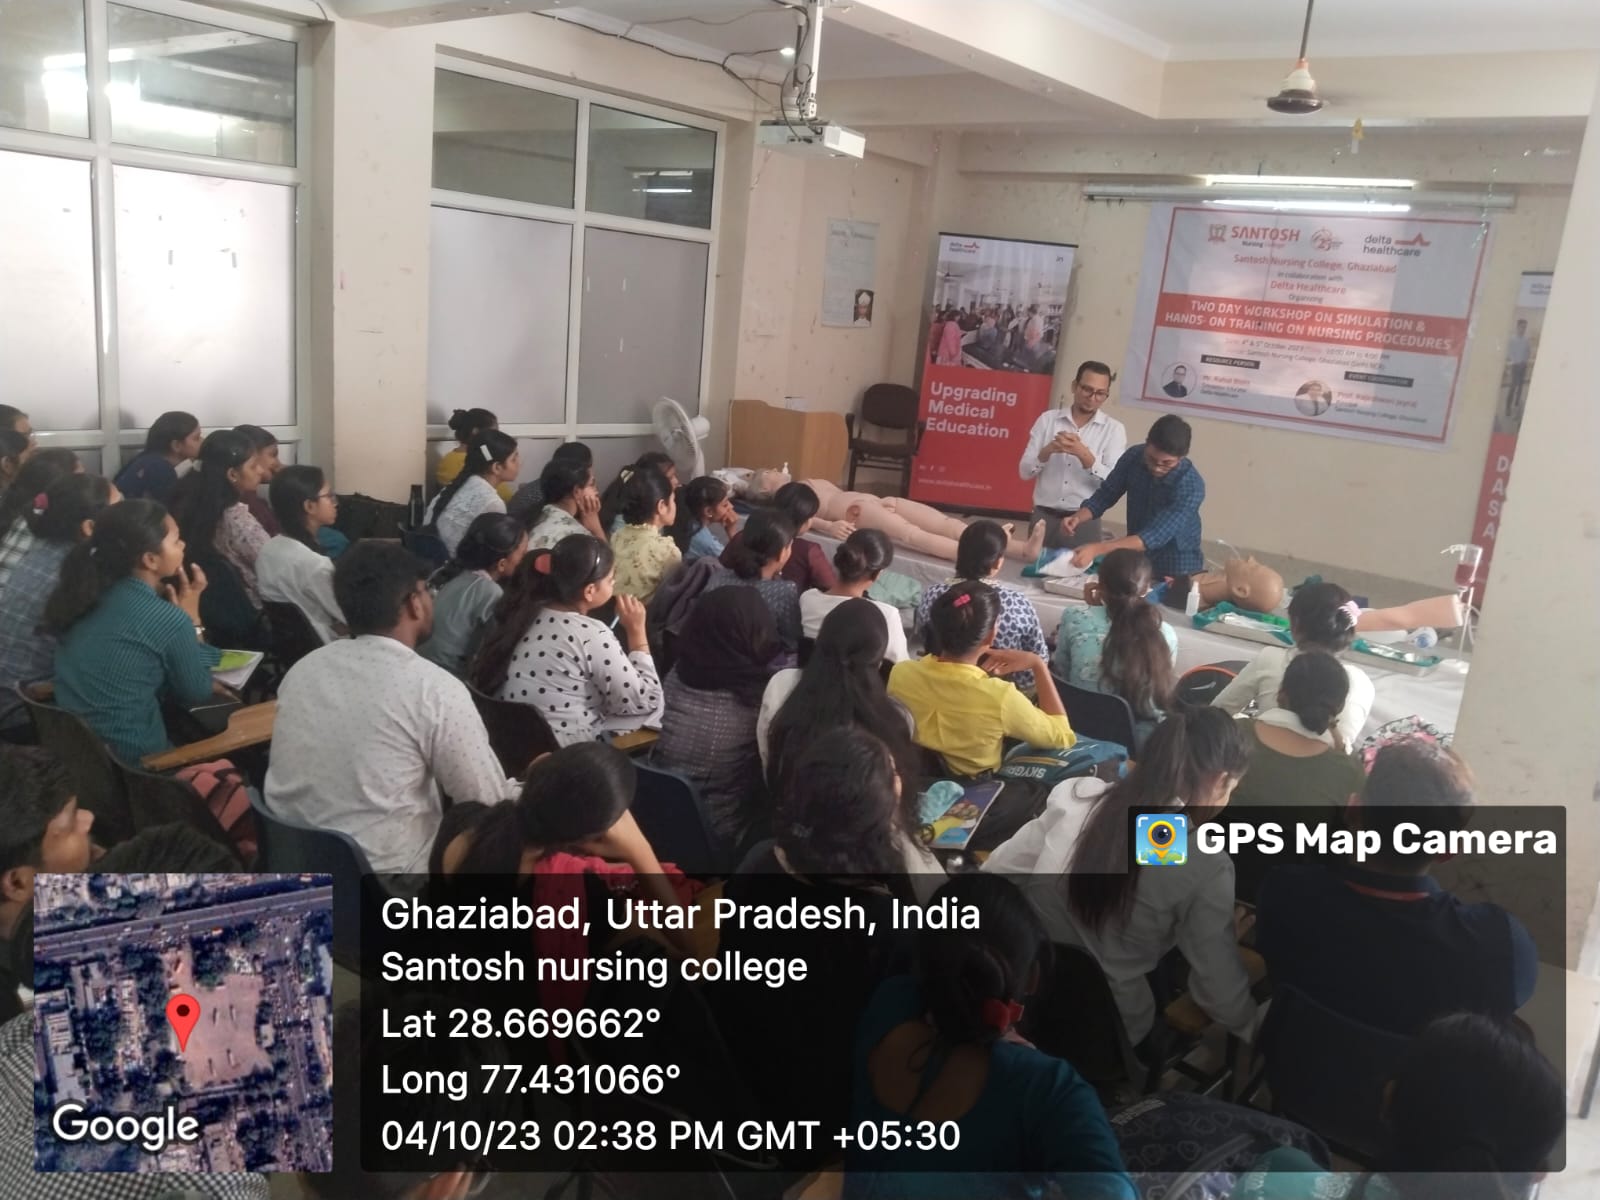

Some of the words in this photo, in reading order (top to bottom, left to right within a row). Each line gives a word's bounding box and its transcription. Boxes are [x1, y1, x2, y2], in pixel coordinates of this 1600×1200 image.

[1231, 226, 1301, 242] SANTOSH
[1364, 234, 1392, 245] delta
[1242, 240, 1264, 248] Nursing
[1363, 245, 1421, 257] healthcare
[1234, 254, 1269, 265] Santosh
[1270, 257, 1306, 269] Nursing
[1347, 262, 1397, 273] Ghaziabad
[1270, 280, 1294, 290] Delta
[1296, 282, 1346, 294] Healthcare
[1191, 300, 1216, 312] TWO
[1218, 303, 1242, 314] DAY
[1244, 305, 1313, 320] WORKSHOP
[1315, 311, 1333, 323] ON
[1335, 313, 1413, 331] SIMULATION
[1415, 321, 1426, 332] &
[1208, 316, 1226, 328] ON
[1229, 318, 1284, 333] TRAINING
[1286, 323, 1305, 335] ON
[1307, 325, 1363, 341] NURSING
[1365, 331, 1452, 351] PROCEDURES
[930, 381, 1018, 407] Upgrading
[928, 399, 995, 419] Medical
[926, 417, 1009, 438] Education
